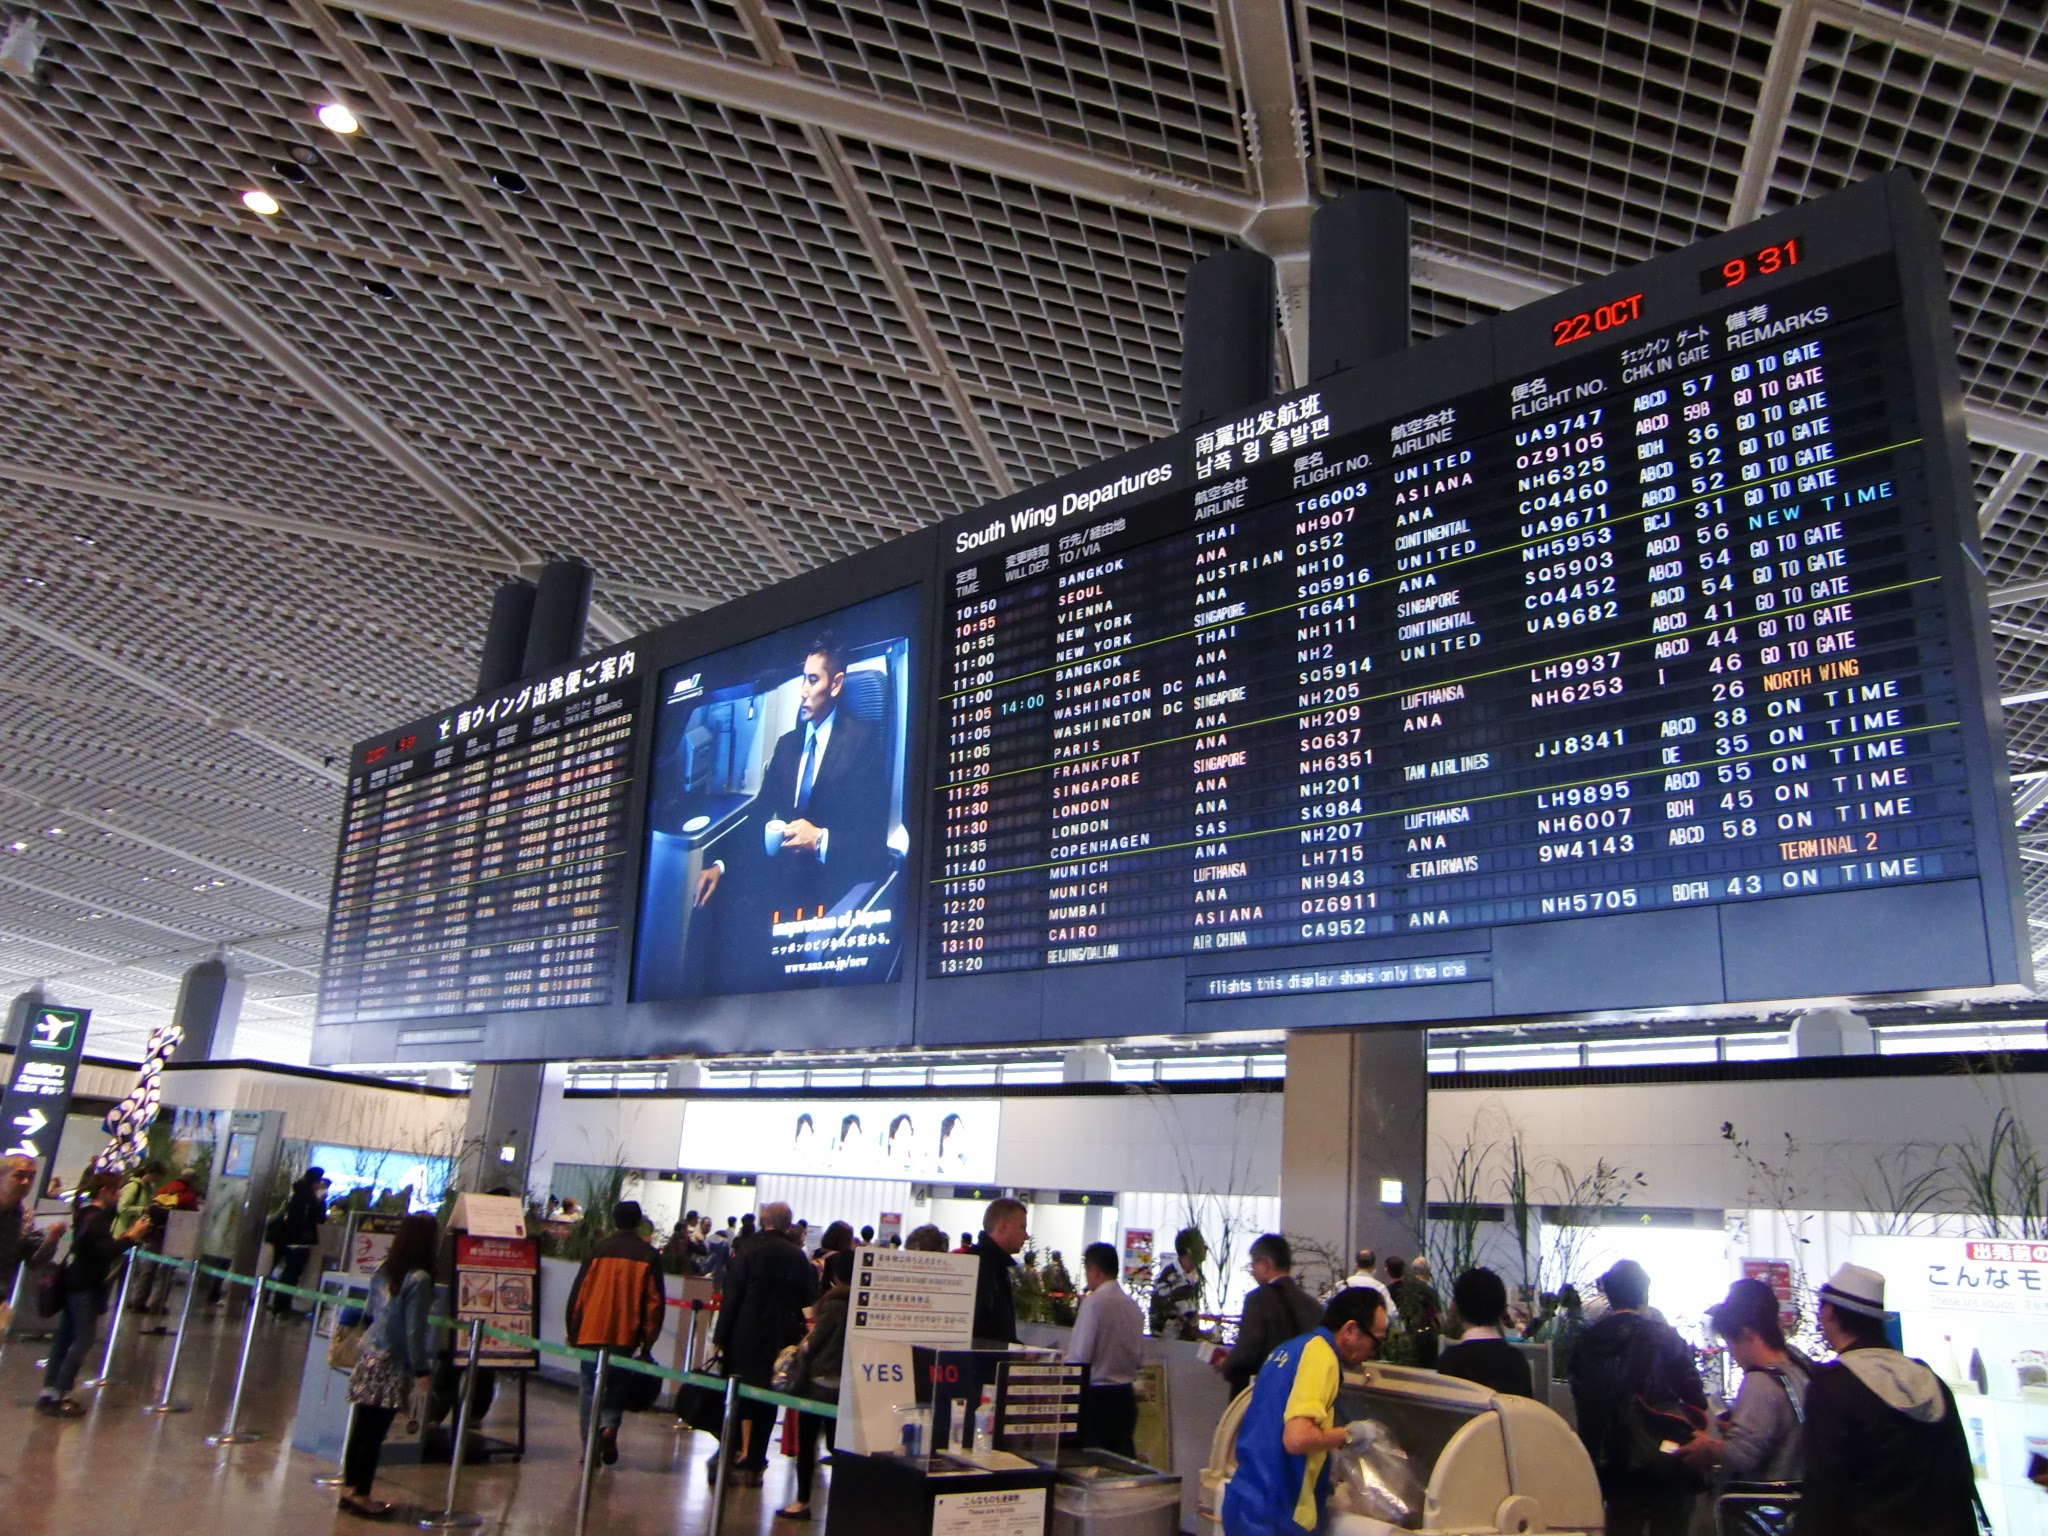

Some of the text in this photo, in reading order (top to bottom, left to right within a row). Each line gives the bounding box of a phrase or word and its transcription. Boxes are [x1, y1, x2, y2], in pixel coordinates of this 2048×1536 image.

[1723, 240, 1797, 287] 9 31
[955, 580, 980, 598] TIME
[1004, 566, 1028, 583] WILL
[1028, 558, 1050, 575] DEP.
[1194, 493, 1245, 522] AIRLINE
[1293, 461, 1344, 489] FLIGHT
[1346, 454, 1372, 472] NO.
[1392, 426, 1453, 458] AIRLINE
[1511, 387, 1573, 420] FLIGHT
[1575, 378, 1608, 399] NO.
[1622, 361, 1655, 384] CHK
[1657, 356, 1673, 373] IN
[1677, 343, 1710, 367] GATE
[1726, 306, 1829, 351] REMARKS
[1194, 476, 1249, 506] 航空会社
[1293, 451, 1324, 474] 便名
[1391, 407, 1457, 442] 航空会社
[1511, 377, 1547, 402] 便名
[1620, 338, 1670, 366] チェックイン
[1676, 324, 1710, 348] ゲート
[1725, 304, 1768, 332] 備考
[1195, 392, 1322, 458] 南翼出发航班
[1196, 414, 1330, 480] 남쪽 윙 출발편
[955, 463, 1173, 553] South Wing Departures
[956, 340, 1822, 621] 10:50 BANGKOK THAI TG6003 UNITED UA9747 ABCD 57 GO TO GATE
[950, 521, 1843, 746] 11:05 WASHINGTON DC ANA NH2 CONTINENTAL CO4452 ABCD 54 GO TO GATE
[951, 482, 1893, 728] 11:05 14:00 SINGAPORE ANA NH111 SINGAPORE SQ5903 ABCD 56 NEW TIME
[456, 650, 636, 735] 南ウイング出発便ご案内
[948, 603, 1853, 801] 11:25 FRANKFURT ANA NH209 LUFTHANSA LH9937 ABCD 44 GO TO GATE
[946, 680, 1899, 858] 11:35 LONDON ANA NH201 TAM AIRLINES JJ8341 ABCD 38 ON TIME
[941, 956, 983, 973] 13:20
[1193, 934, 1212, 950] AIR
[1216, 930, 1248, 948] CHINA
[1301, 918, 1366, 938] CA952
[1409, 910, 1450, 927] ANA
[1542, 888, 1638, 914] NH5705
[1672, 881, 1710, 902] BDFH
[1727, 875, 1763, 896] 43
[1783, 868, 1820, 889] ON
[1841, 858, 1920, 881] TIME
[942, 832, 1878, 953] 13:10 CAIRO ASIANA OZ6911 TERMINAL 2
[943, 917, 984, 934] 12:20
[1049, 902, 1105, 920] MUMBAI
[1195, 887, 1227, 903] ANA
[1301, 869, 1365, 890] NH943
[1539, 834, 1635, 863] 9W4143
[1669, 825, 1705, 846] ABCD
[1723, 818, 1758, 839] 58
[1778, 810, 1813, 830] ON
[1836, 797, 1912, 822] TIME
[862, 1364, 903, 1382] YES
[929, 1365, 959, 1383] NO
